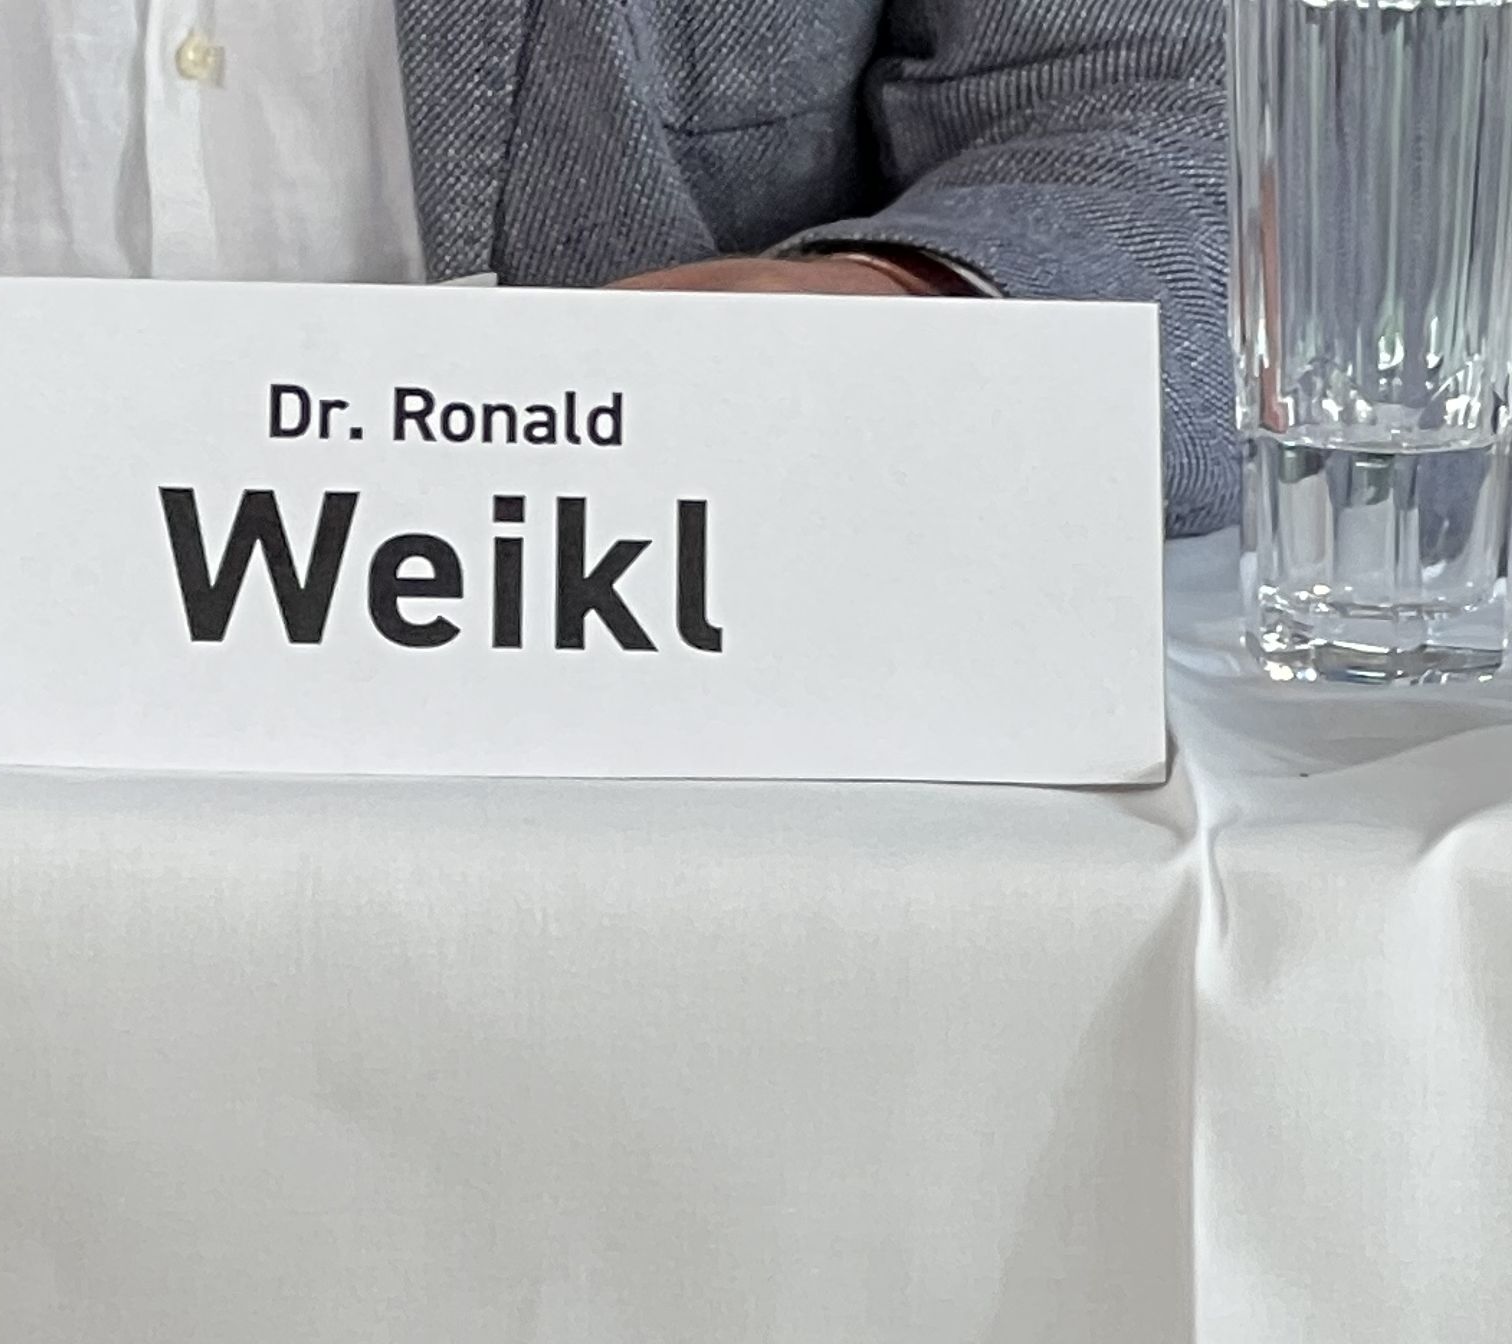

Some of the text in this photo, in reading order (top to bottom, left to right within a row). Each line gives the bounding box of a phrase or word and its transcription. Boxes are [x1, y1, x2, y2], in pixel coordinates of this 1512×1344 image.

[268, 383, 624, 446] Dr. Ronald
[157, 485, 724, 654] Weikl
